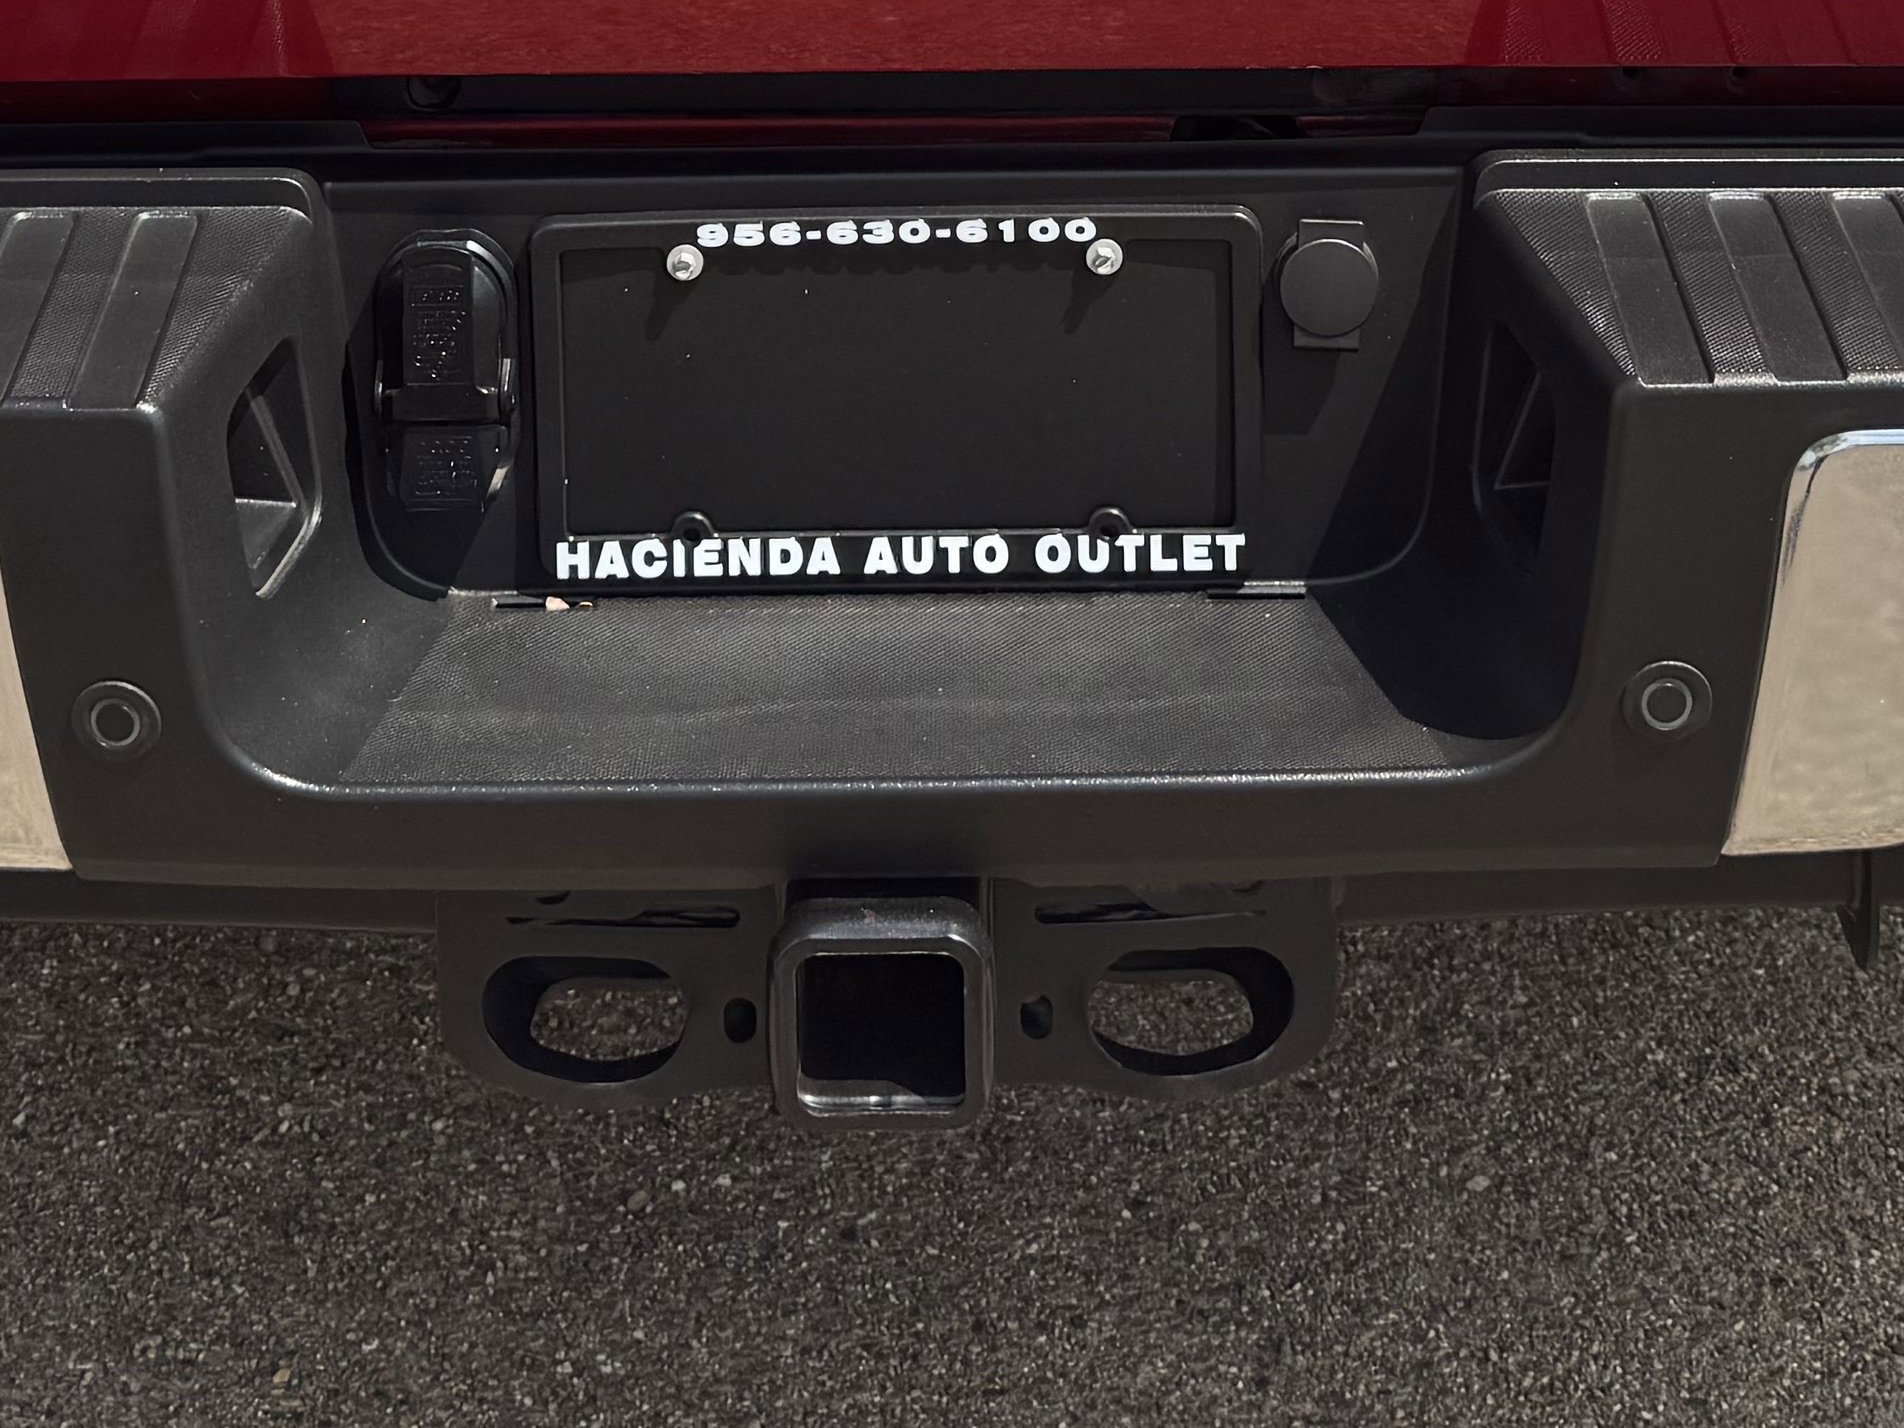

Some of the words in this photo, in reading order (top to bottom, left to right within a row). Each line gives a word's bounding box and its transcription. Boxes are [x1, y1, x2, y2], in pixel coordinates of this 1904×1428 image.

[696, 217, 1097, 247] 956-630-6100
[555, 535, 841, 580] HACIENDA
[862, 532, 1009, 575] AUTO
[1034, 531, 1247, 573] OUTLET
